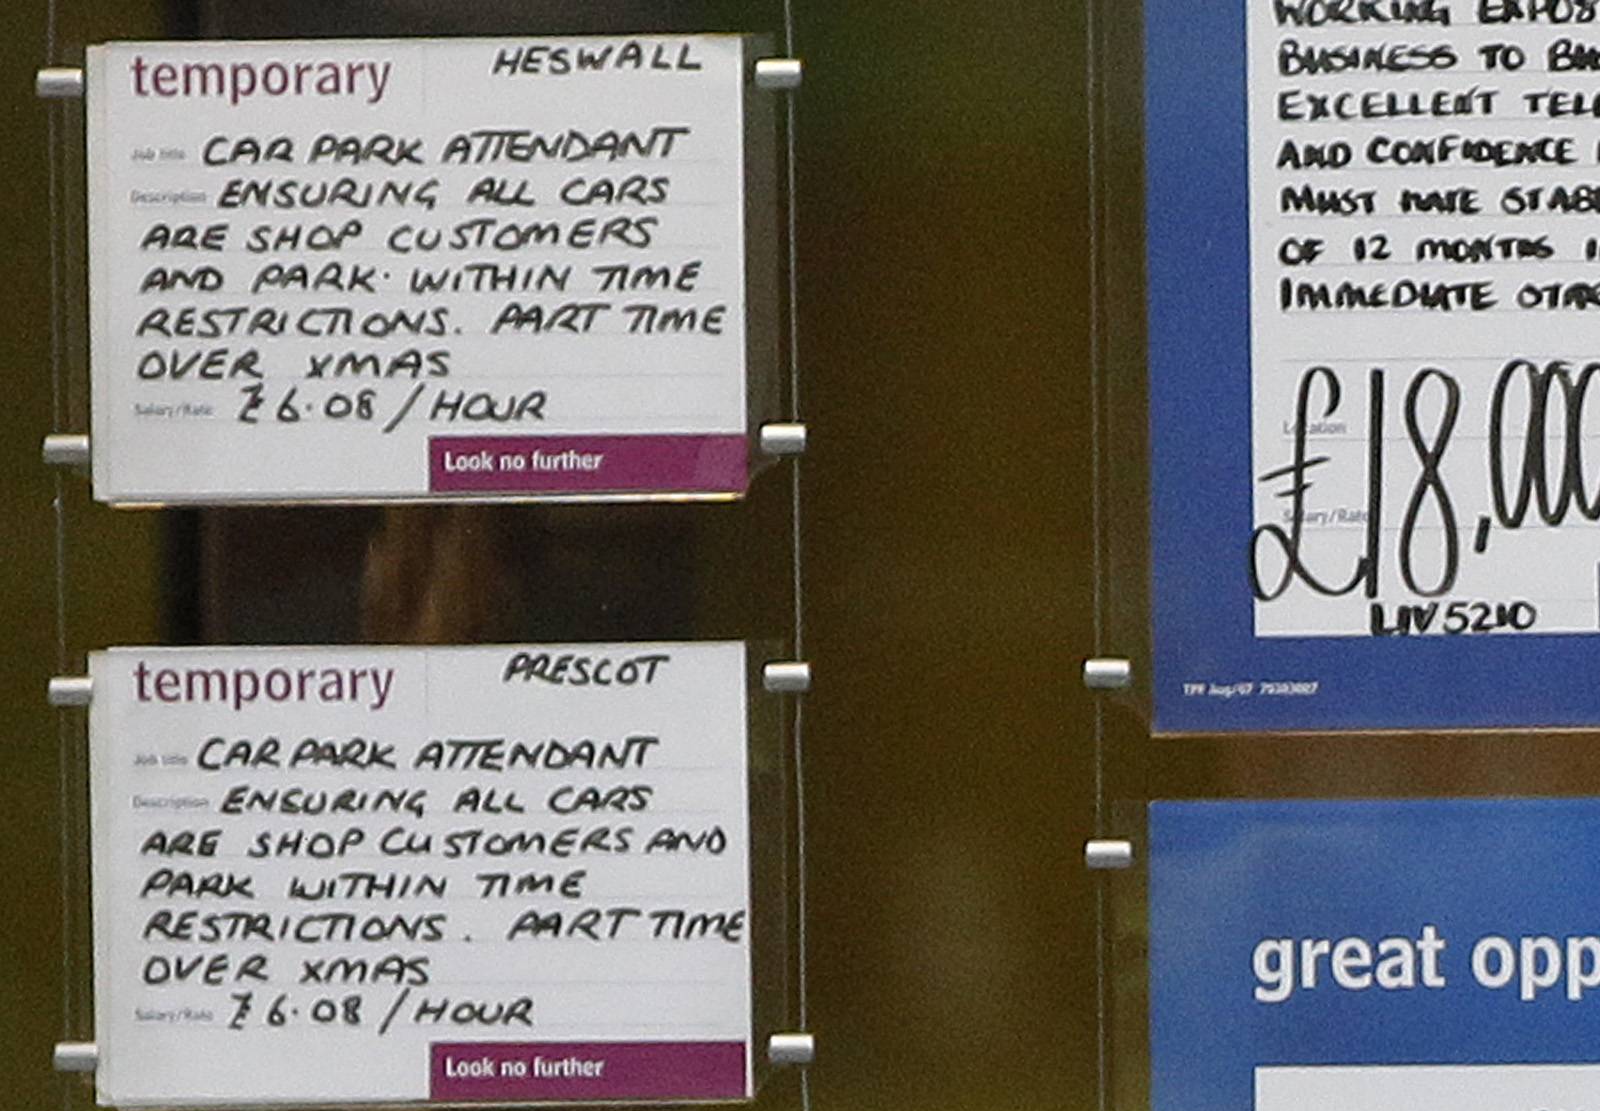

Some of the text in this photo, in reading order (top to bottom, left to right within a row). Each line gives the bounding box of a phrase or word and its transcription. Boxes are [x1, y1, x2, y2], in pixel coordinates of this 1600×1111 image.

[493, 40, 701, 75] HESWALL
[1278, 39, 1458, 76] BUSINESS
[1479, 44, 1525, 71] TO
[131, 56, 390, 106] temporary
[1278, 87, 1498, 122] EXCELLENT
[203, 127, 690, 166] CAR PARK ATTENDANT
[1277, 140, 1352, 170] AND
[1367, 135, 1577, 167] CONFIDENCE
[218, 175, 669, 210] ENSURING ALL CARS
[1282, 184, 1376, 216] MUST
[141, 217, 658, 254] ARE SHOP CUSTOMERS
[1279, 238, 1323, 266] OF
[1354, 235, 1391, 262] 12
[141, 266, 223, 293] AND
[410, 263, 571, 295] WITHIN
[592, 261, 702, 292] TIME
[1281, 278, 1497, 311] IMMEDIATE
[136, 303, 726, 338] RESTRICTIONS. PART TIME
[137, 348, 450, 380] OVER XMAS
[445, 450, 603, 471] Look no further
[134, 661, 393, 711] temporary
[504, 652, 670, 686] PRESCOT
[414, 737, 659, 772] ATTENDANT
[141, 868, 586, 901] PARK WITHIN TIME
[508, 908, 745, 943] PART TIME
[143, 954, 429, 986] OVER XMAS
[1254, 927, 1445, 1001] great
[447, 1057, 603, 1077] Look no further
